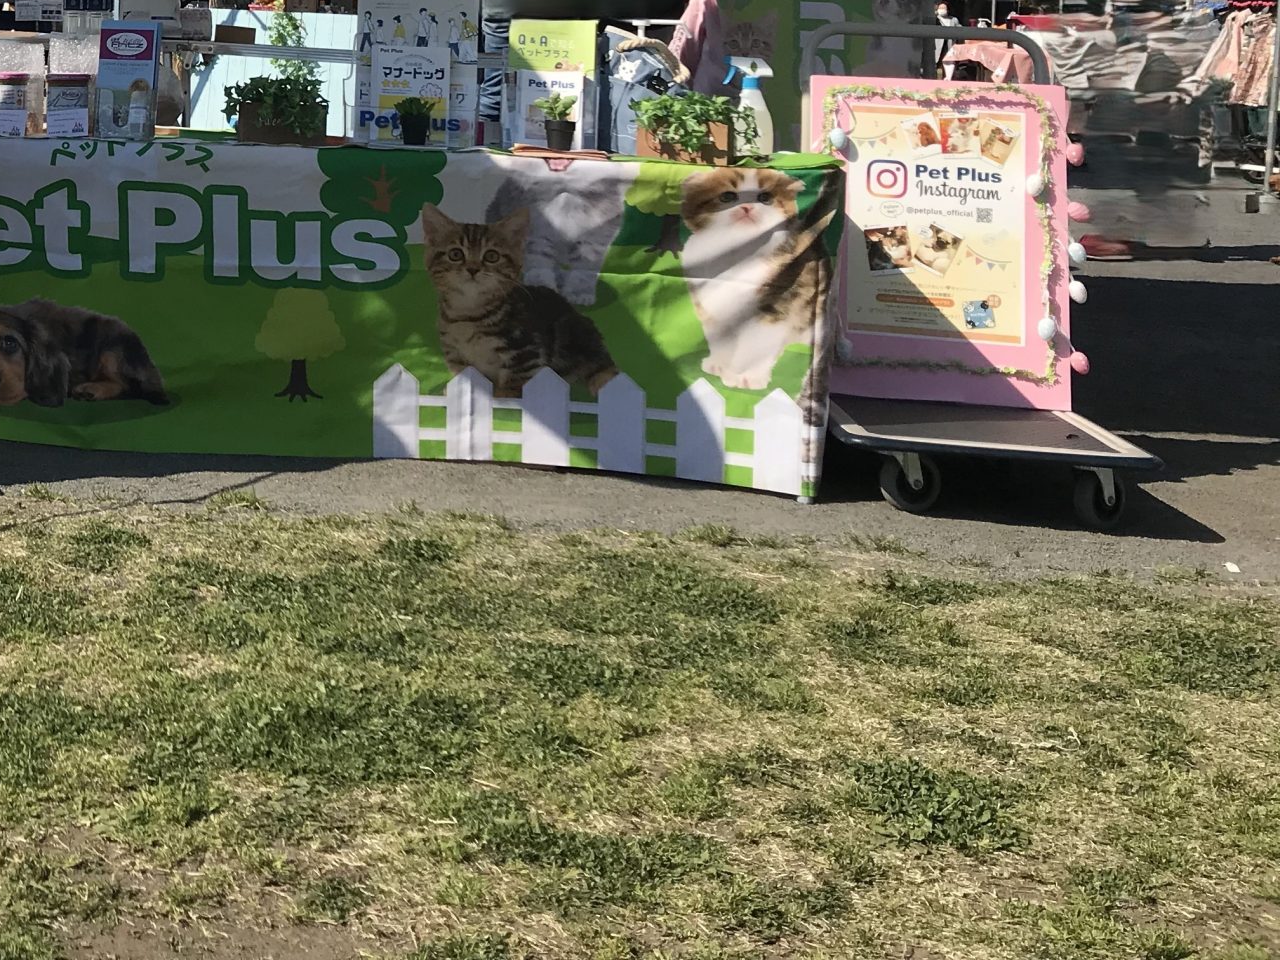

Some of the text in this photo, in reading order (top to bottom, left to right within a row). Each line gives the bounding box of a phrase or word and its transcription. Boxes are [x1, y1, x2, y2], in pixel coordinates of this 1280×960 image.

[518, 34, 526, 46] Q
[540, 35, 548, 47] A
[528, 79, 576, 89] Pet Plus
[915, 164, 1003, 183] Pet Plus
[915, 179, 1003, 206] Instagram
[906, 205, 974, 218] @petplus_official
[123, 186, 404, 287] Plus
